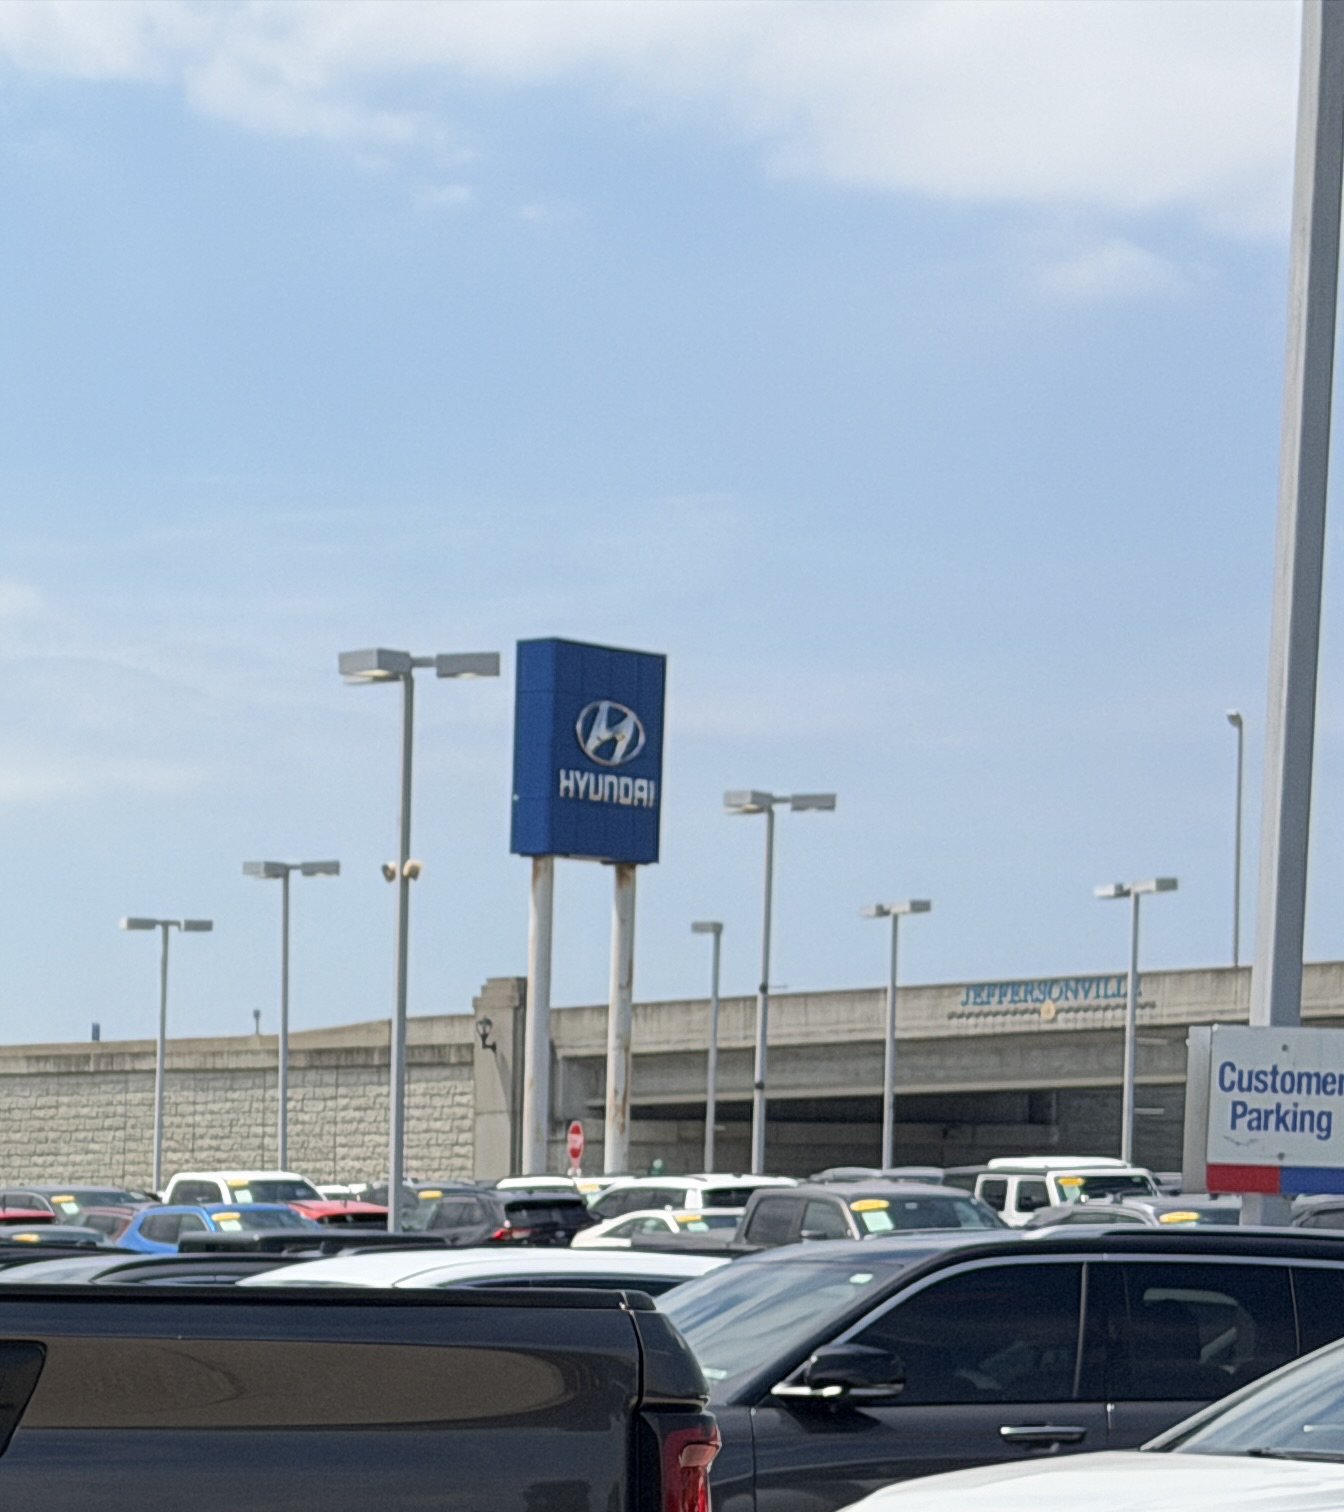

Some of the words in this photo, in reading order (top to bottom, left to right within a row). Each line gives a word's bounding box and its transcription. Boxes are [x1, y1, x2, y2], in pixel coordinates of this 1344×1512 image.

[559, 768, 655, 808] HYUNDAI
[961, 974, 1142, 1006] JEFFERSONVILL
[1230, 1100, 1333, 1141] Parking
